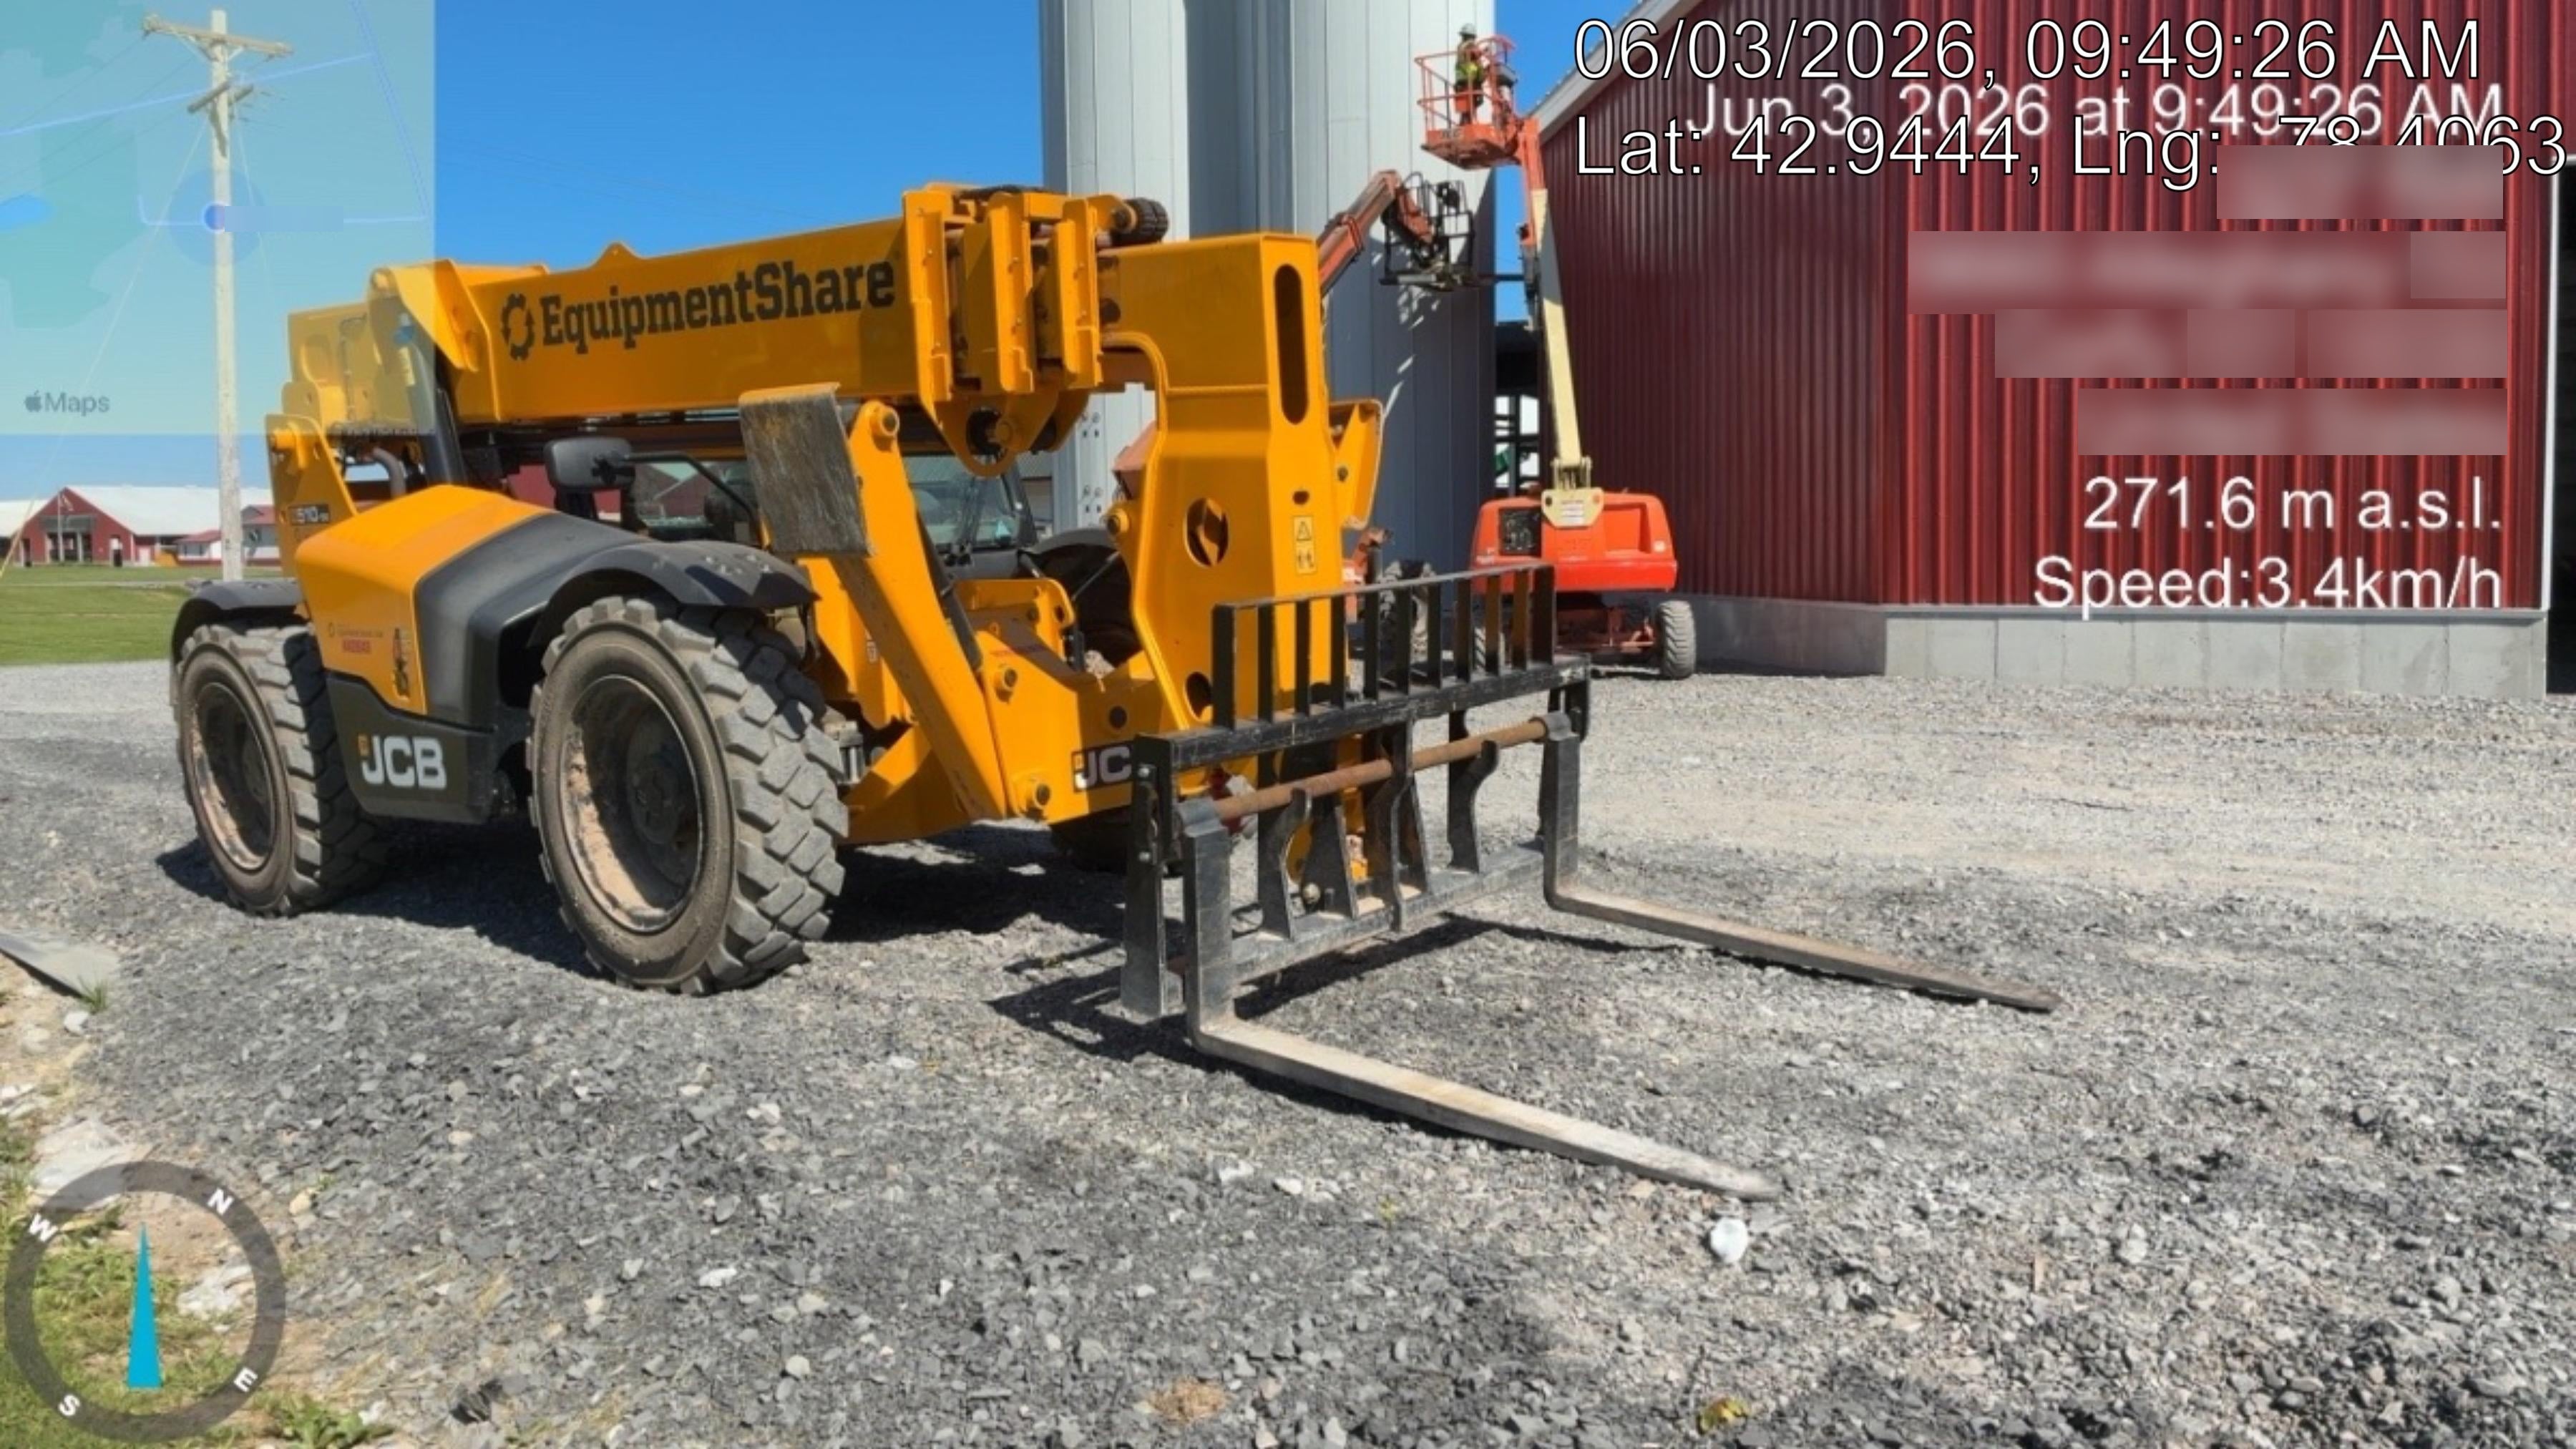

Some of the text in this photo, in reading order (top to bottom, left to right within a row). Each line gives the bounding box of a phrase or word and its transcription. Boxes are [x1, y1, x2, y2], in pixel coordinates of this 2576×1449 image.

[540, 260, 895, 354] EquipmentShare
[362, 735, 447, 790] JCB
[1075, 746, 1132, 789] JC
